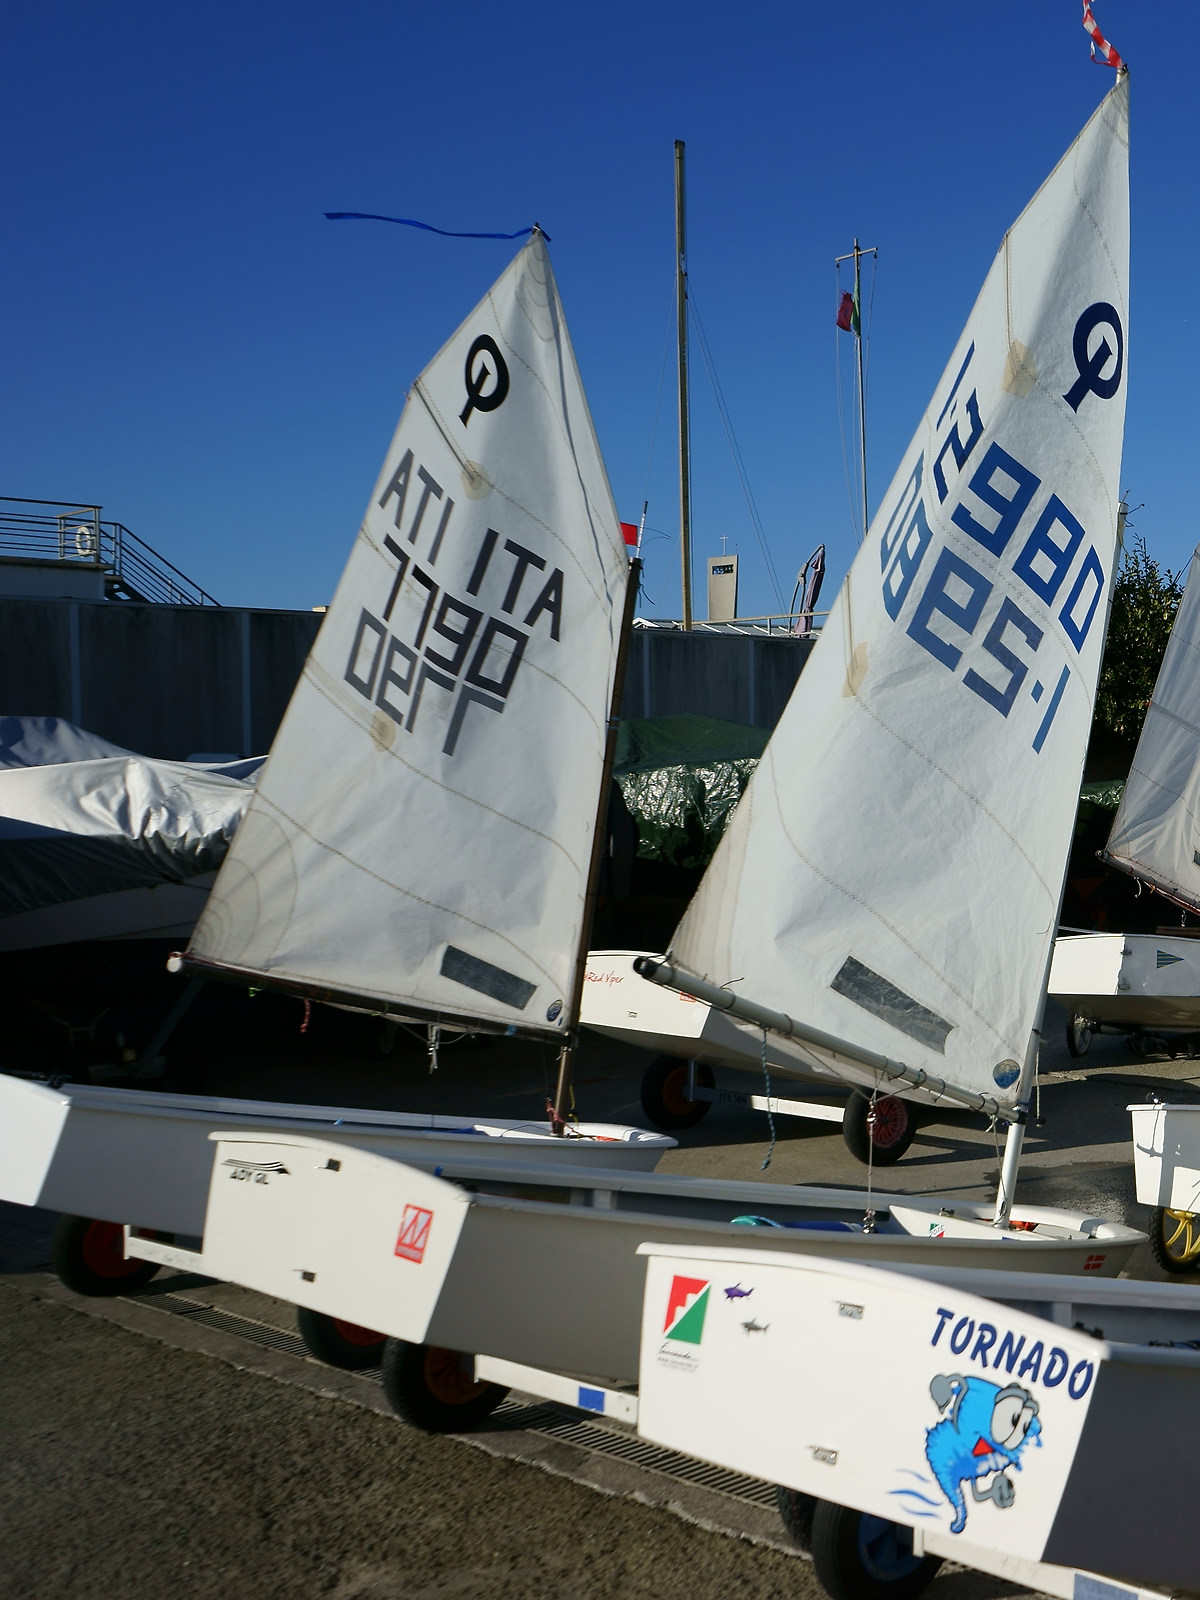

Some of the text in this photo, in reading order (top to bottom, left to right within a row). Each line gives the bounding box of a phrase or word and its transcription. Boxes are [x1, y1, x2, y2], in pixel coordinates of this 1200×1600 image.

[383, 533, 530, 699] 7790
[466, 528, 564, 642] ITA
[931, 1307, 1094, 1400] TORNADO
